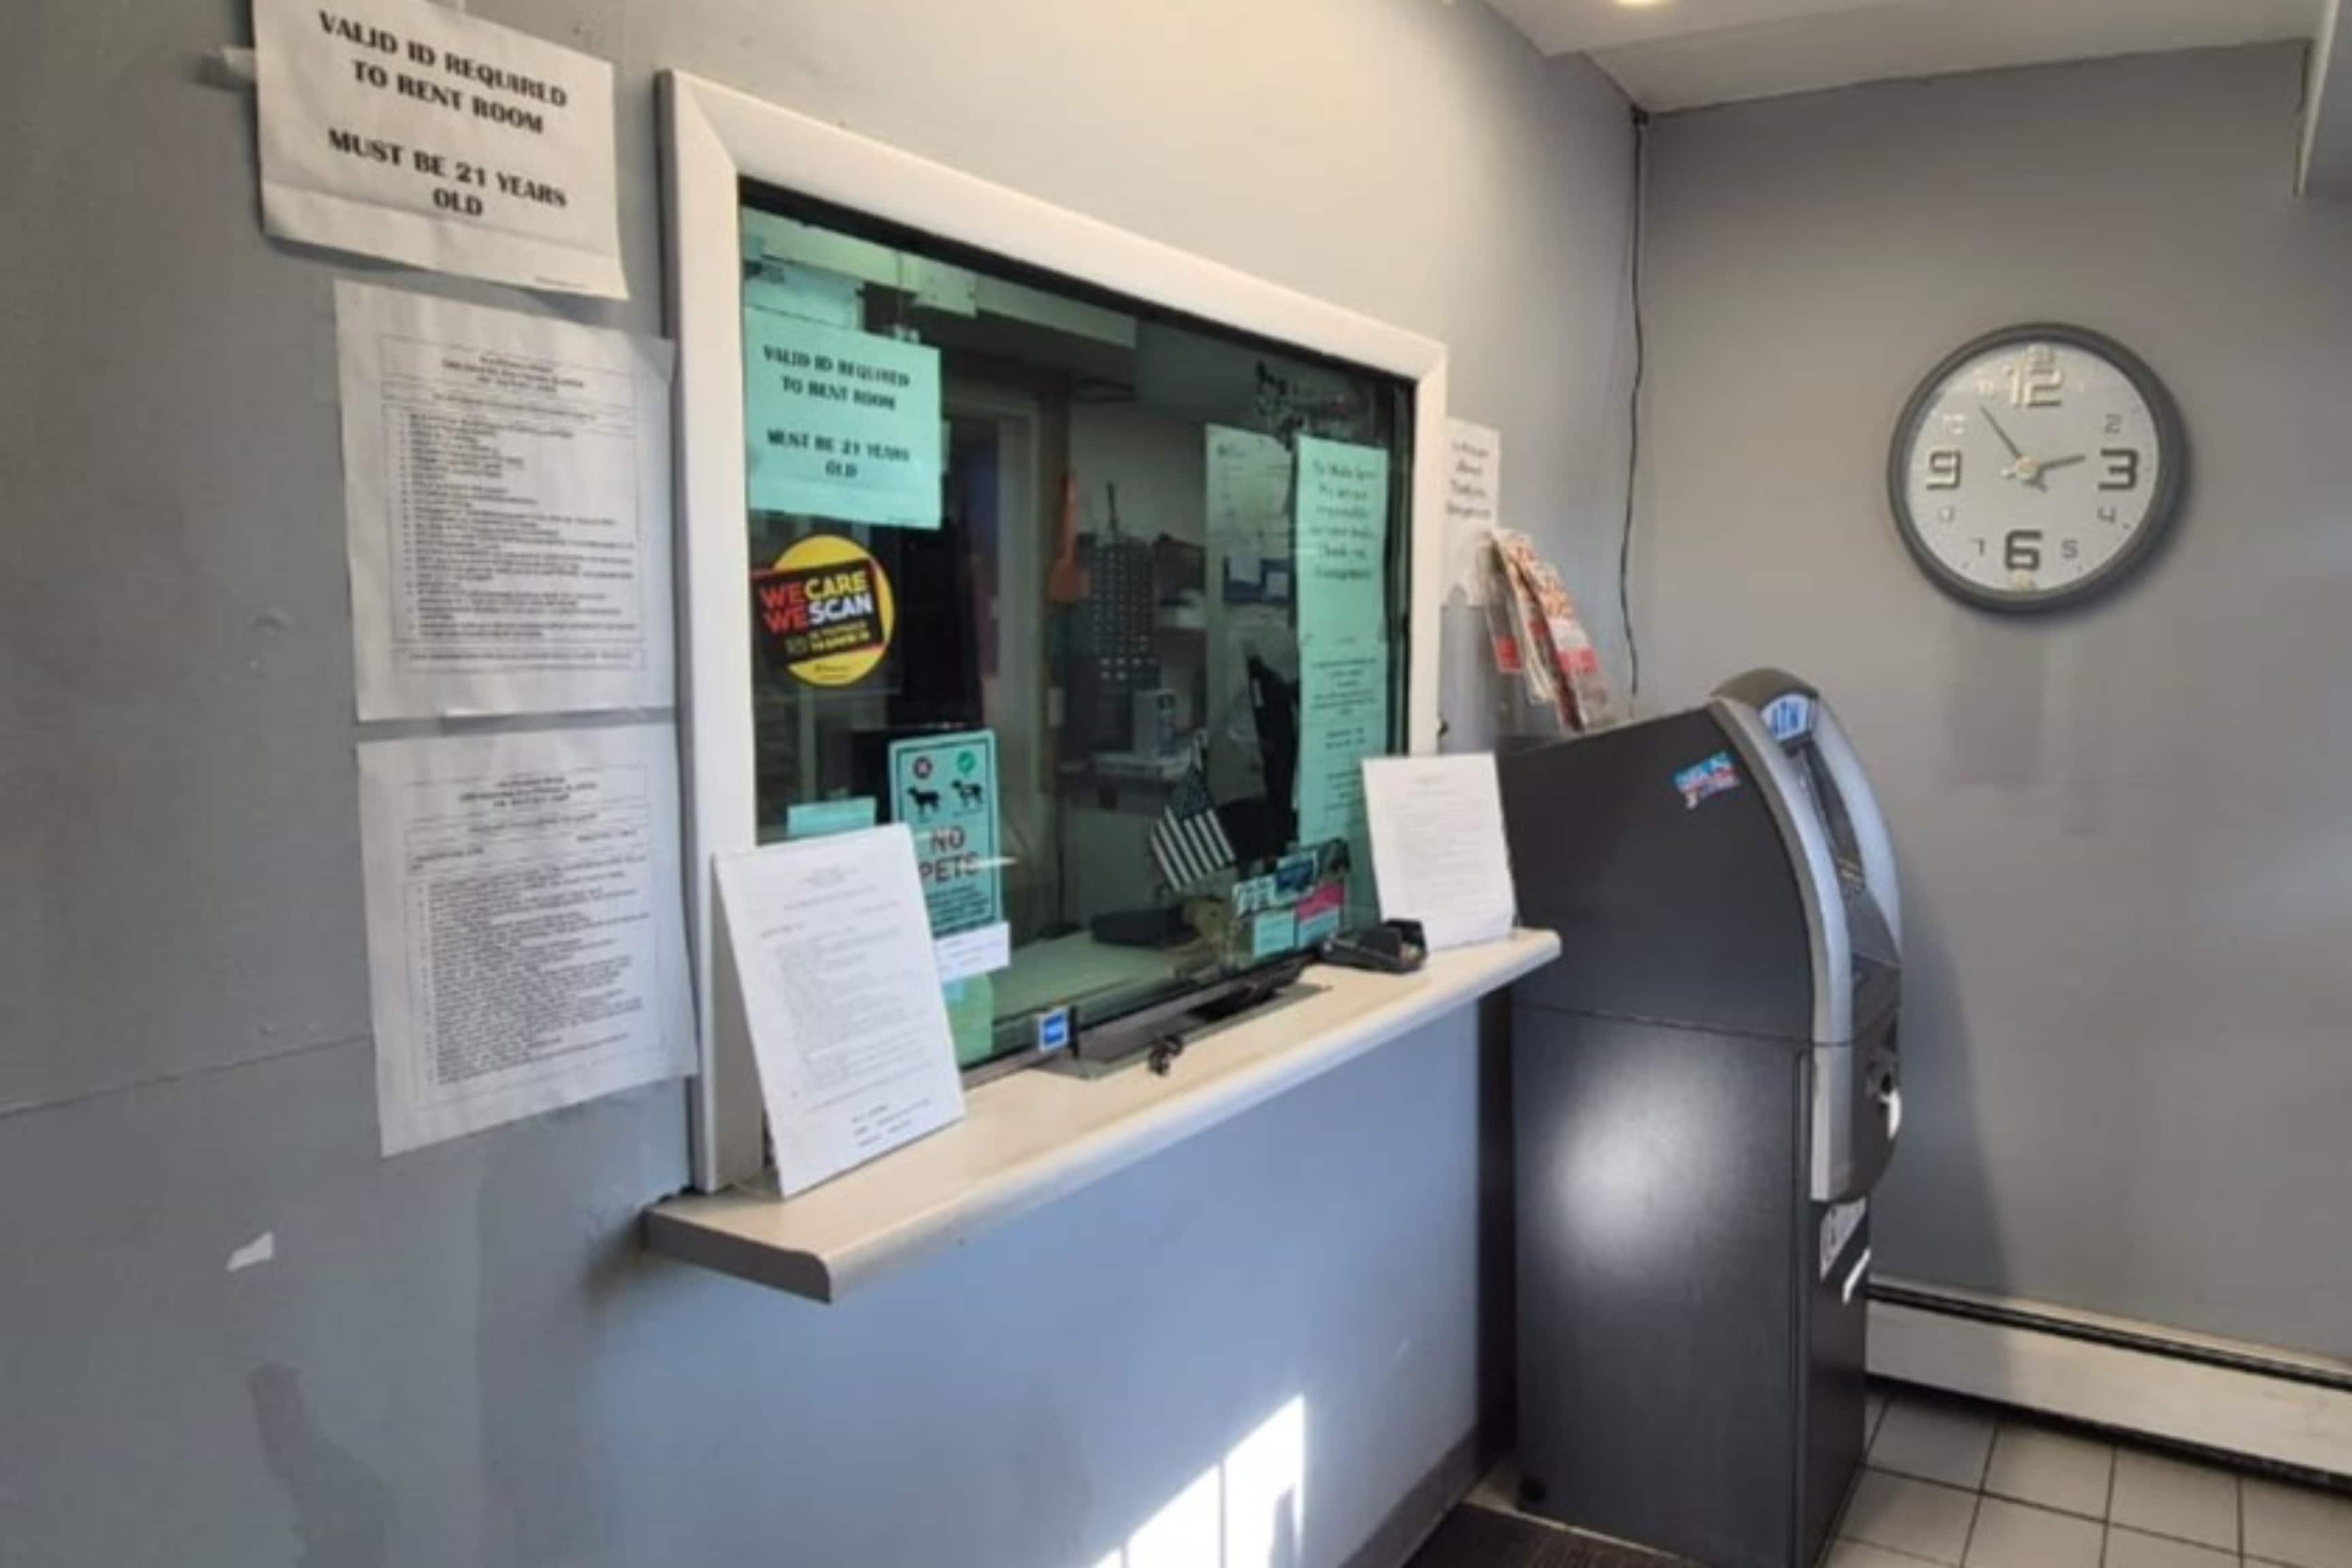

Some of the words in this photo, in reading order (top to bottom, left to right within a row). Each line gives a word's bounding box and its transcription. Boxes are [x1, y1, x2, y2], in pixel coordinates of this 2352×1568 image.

[319, 12, 398, 54] VALID
[408, 39, 436, 67] ID
[445, 52, 566, 108] REQUIRED
[352, 61, 387, 88] TO
[397, 76, 463, 111] RENT
[472, 97, 544, 135] ROOM
[327, 129, 405, 167] MUST
[413, 150, 446, 177] BE
[455, 162, 487, 187] 21
[497, 170, 567, 208] YEARS
[433, 188, 483, 216] OLD
[764, 344, 811, 368] VALID
[814, 355, 834, 372] ID
[782, 376, 804, 395] TO
[808, 380, 849, 402] RENT
[2004, 363, 2062, 408] 12
[2104, 413, 2123, 434] 2
[814, 436, 834, 452] BE
[840, 439, 860, 456] 21
[825, 459, 858, 478] OLD
[1925, 449, 1961, 491] 9
[2098, 448, 2139, 491] 3
[2097, 506, 2117, 523] 4
[1972, 538, 1986, 557] 7
[2004, 529, 2043, 571] 6
[2061, 539, 2078, 559] 5
[930, 826, 965, 852] NO
